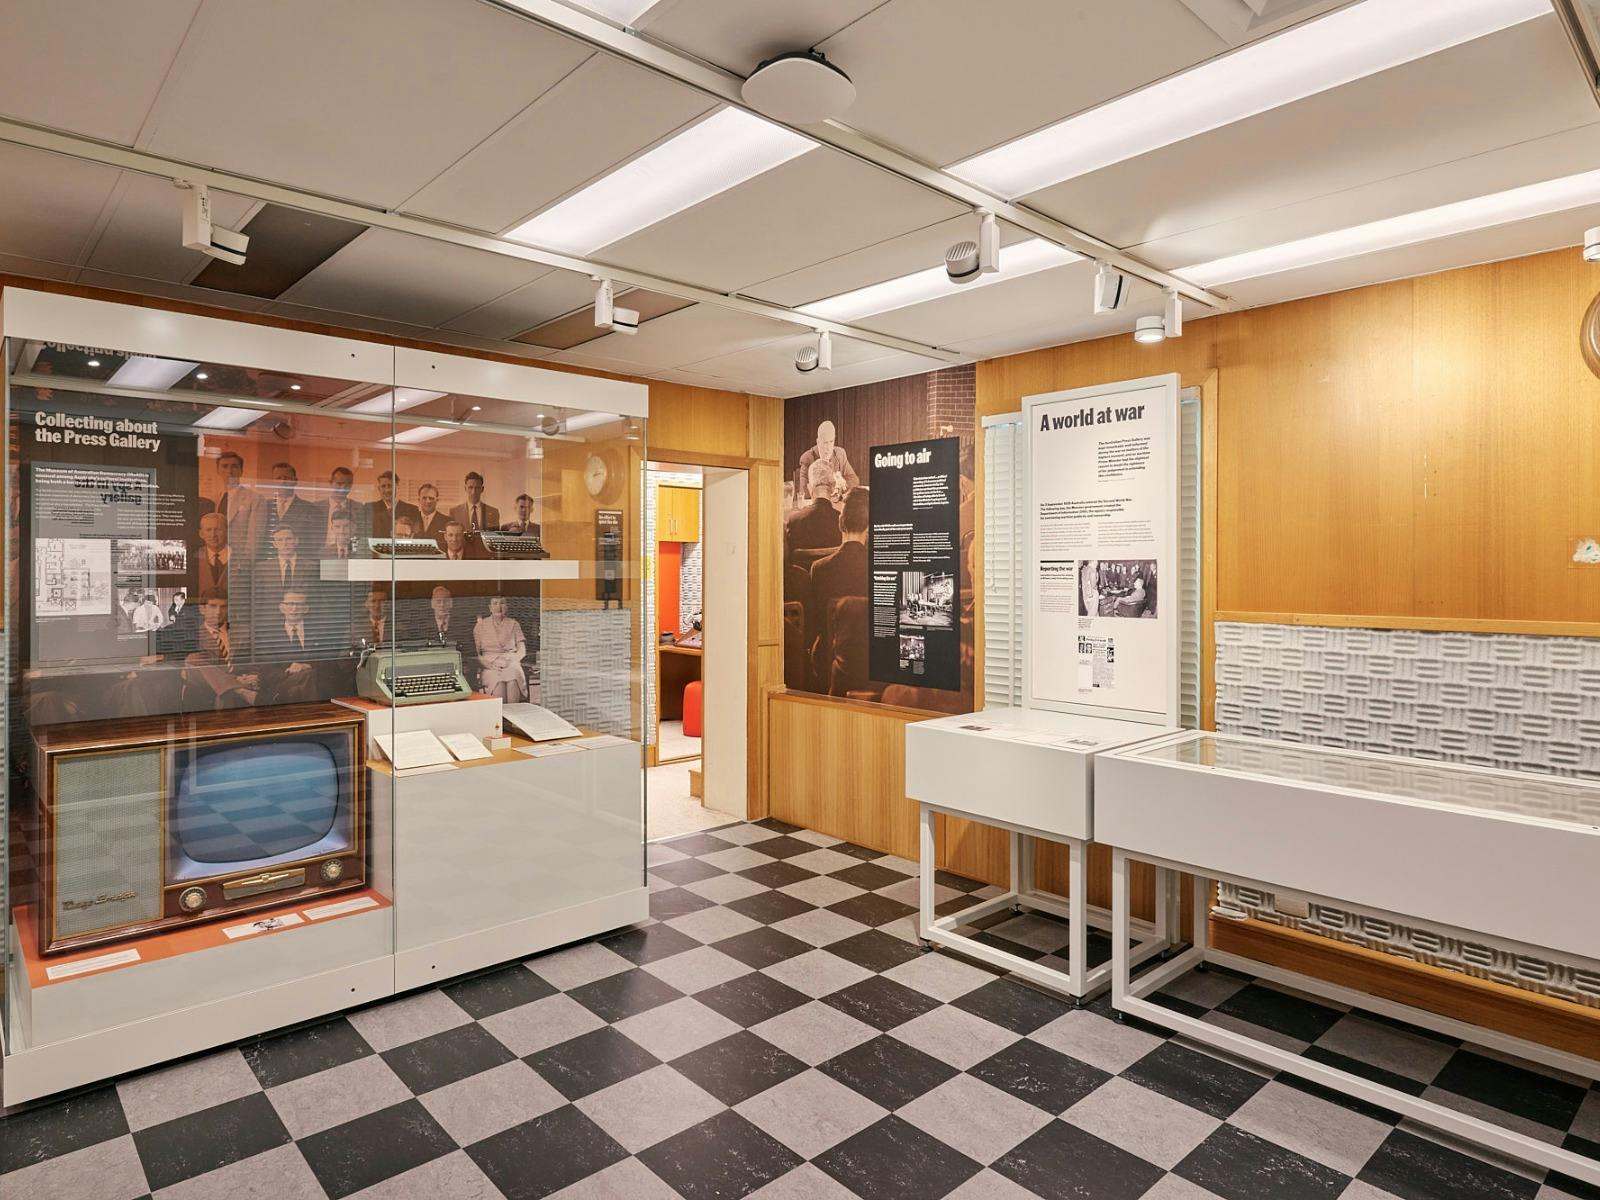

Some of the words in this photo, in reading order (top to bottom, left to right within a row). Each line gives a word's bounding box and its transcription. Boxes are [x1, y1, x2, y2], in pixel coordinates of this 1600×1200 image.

[35, 411, 113, 434] Collecting
[116, 418, 158, 435] about
[1040, 414, 1050, 431] A
[1052, 408, 1094, 429] world
[1097, 407, 1112, 424] at
[1115, 405, 1145, 422] war
[35, 428, 61, 443] the
[64, 430, 107, 446] Press
[110, 433, 160, 452] Gallery
[875, 452, 904, 469] Going
[904, 452, 916, 465] to
[916, 448, 932, 464] air
